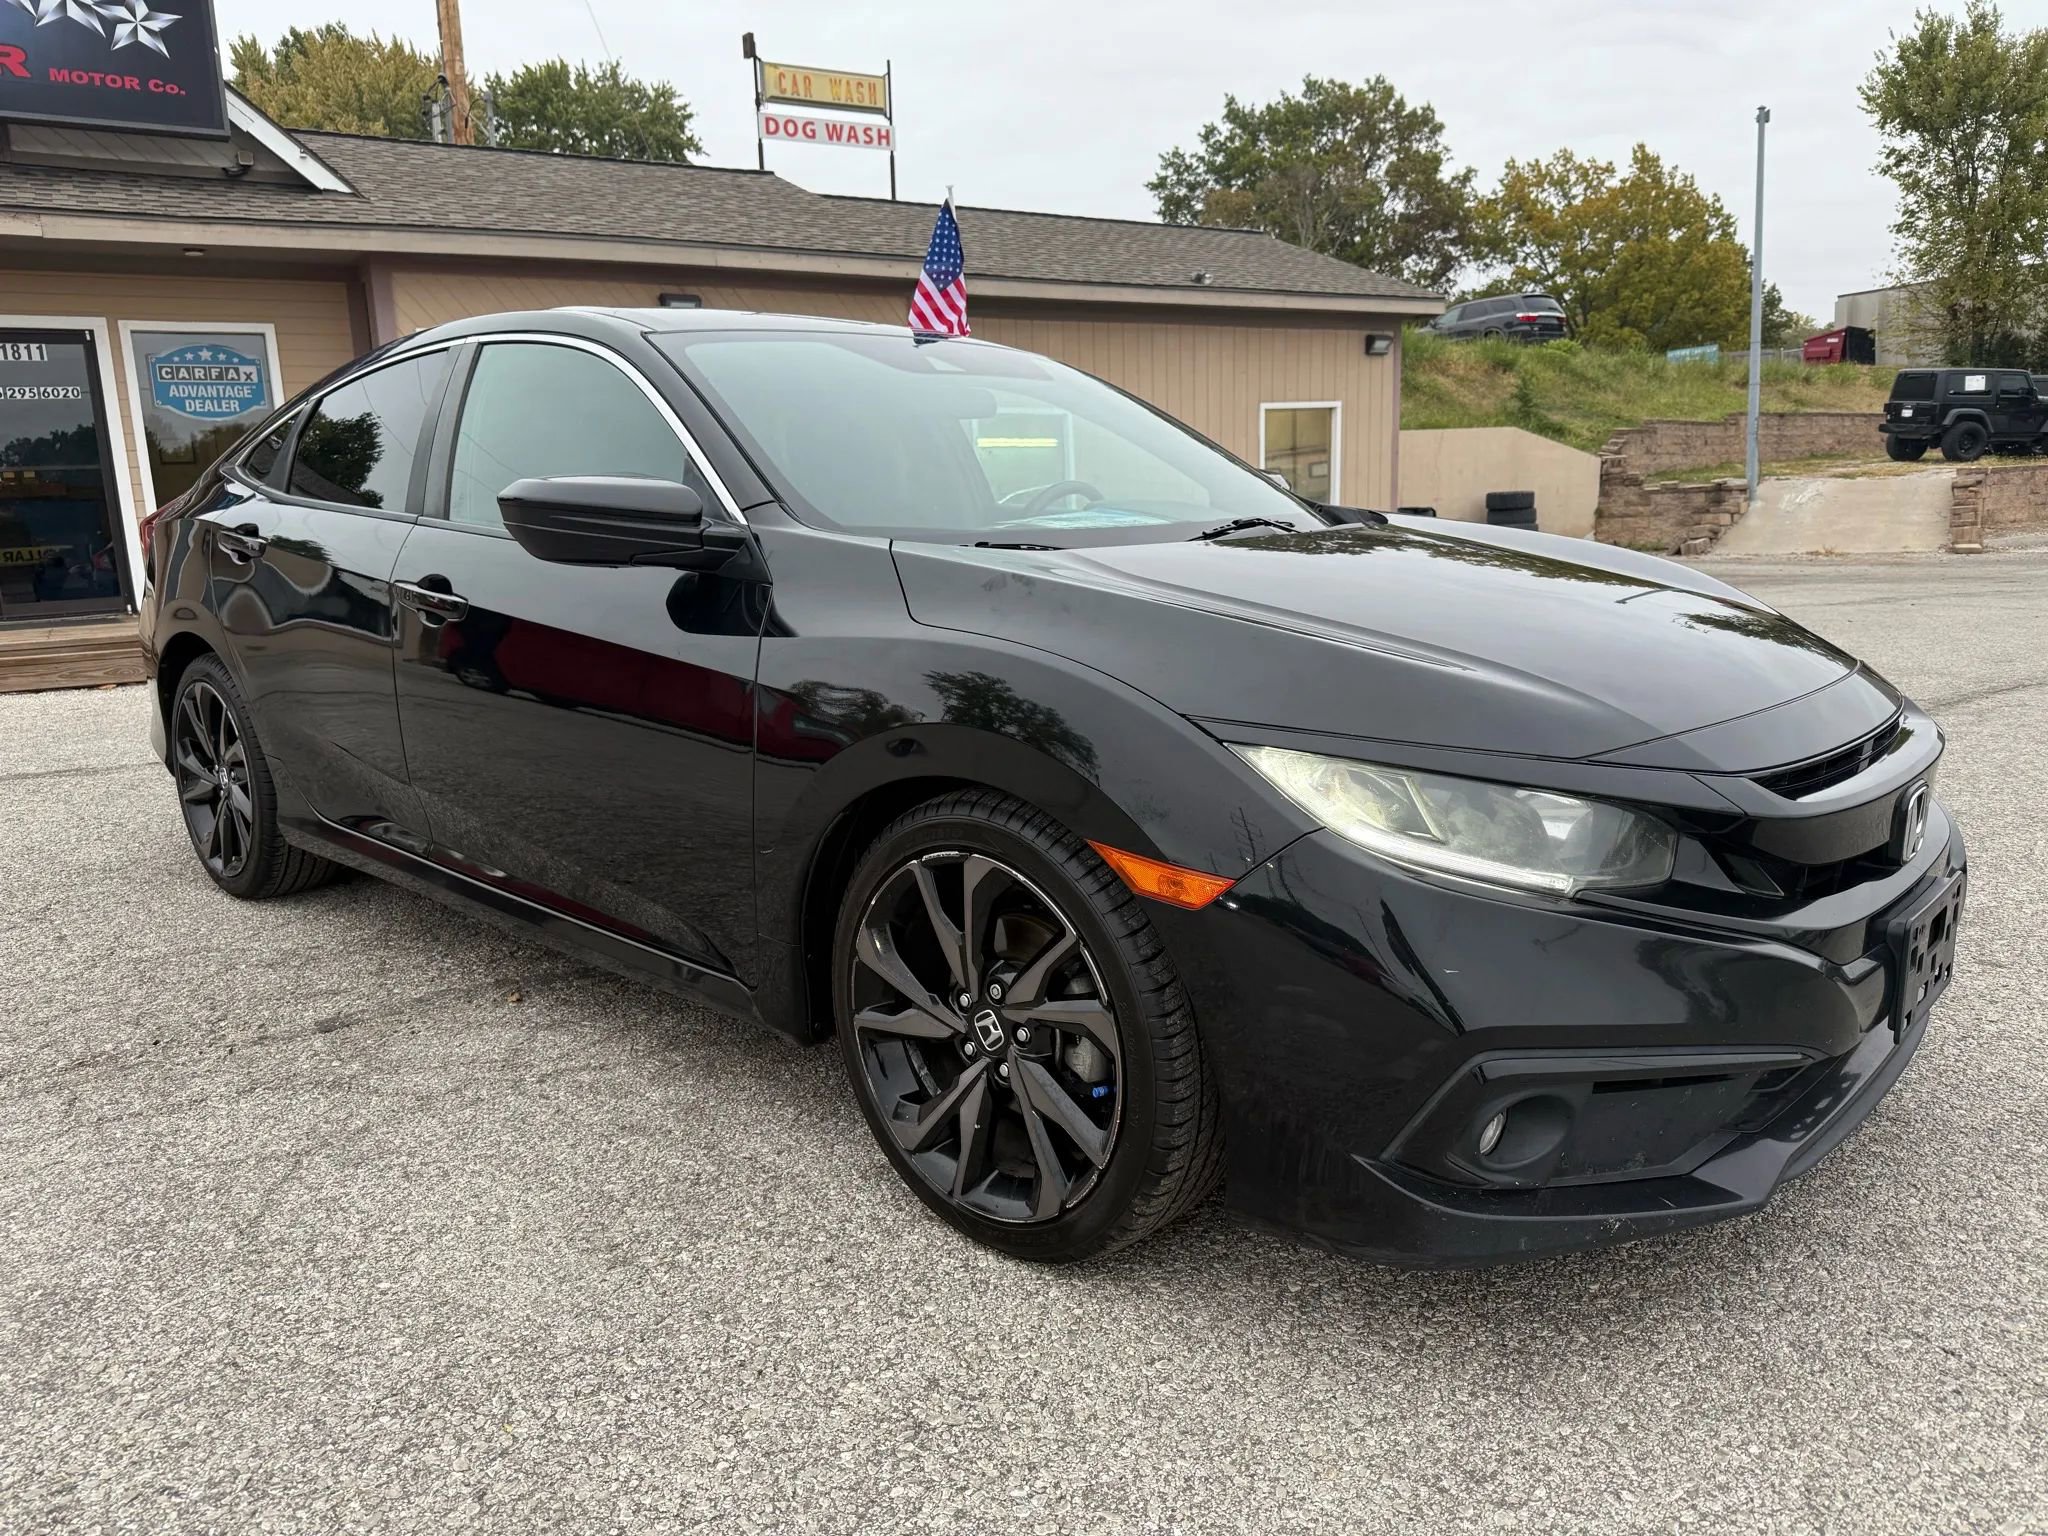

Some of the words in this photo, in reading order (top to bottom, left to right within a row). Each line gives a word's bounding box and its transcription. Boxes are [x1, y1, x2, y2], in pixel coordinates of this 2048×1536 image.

[48, 67, 141, 90] MOTOR
[148, 79, 186, 95] Co.
[778, 71, 813, 98] CAR
[829, 77, 878, 105] WASH
[765, 116, 816, 140] DOG
[825, 122, 891, 147] WASH
[0, 343, 45, 360] 1811
[159, 365, 256, 382] CARFAX
[169, 384, 253, 398] ADVANTAGE
[185, 399, 240, 412] DEALER
